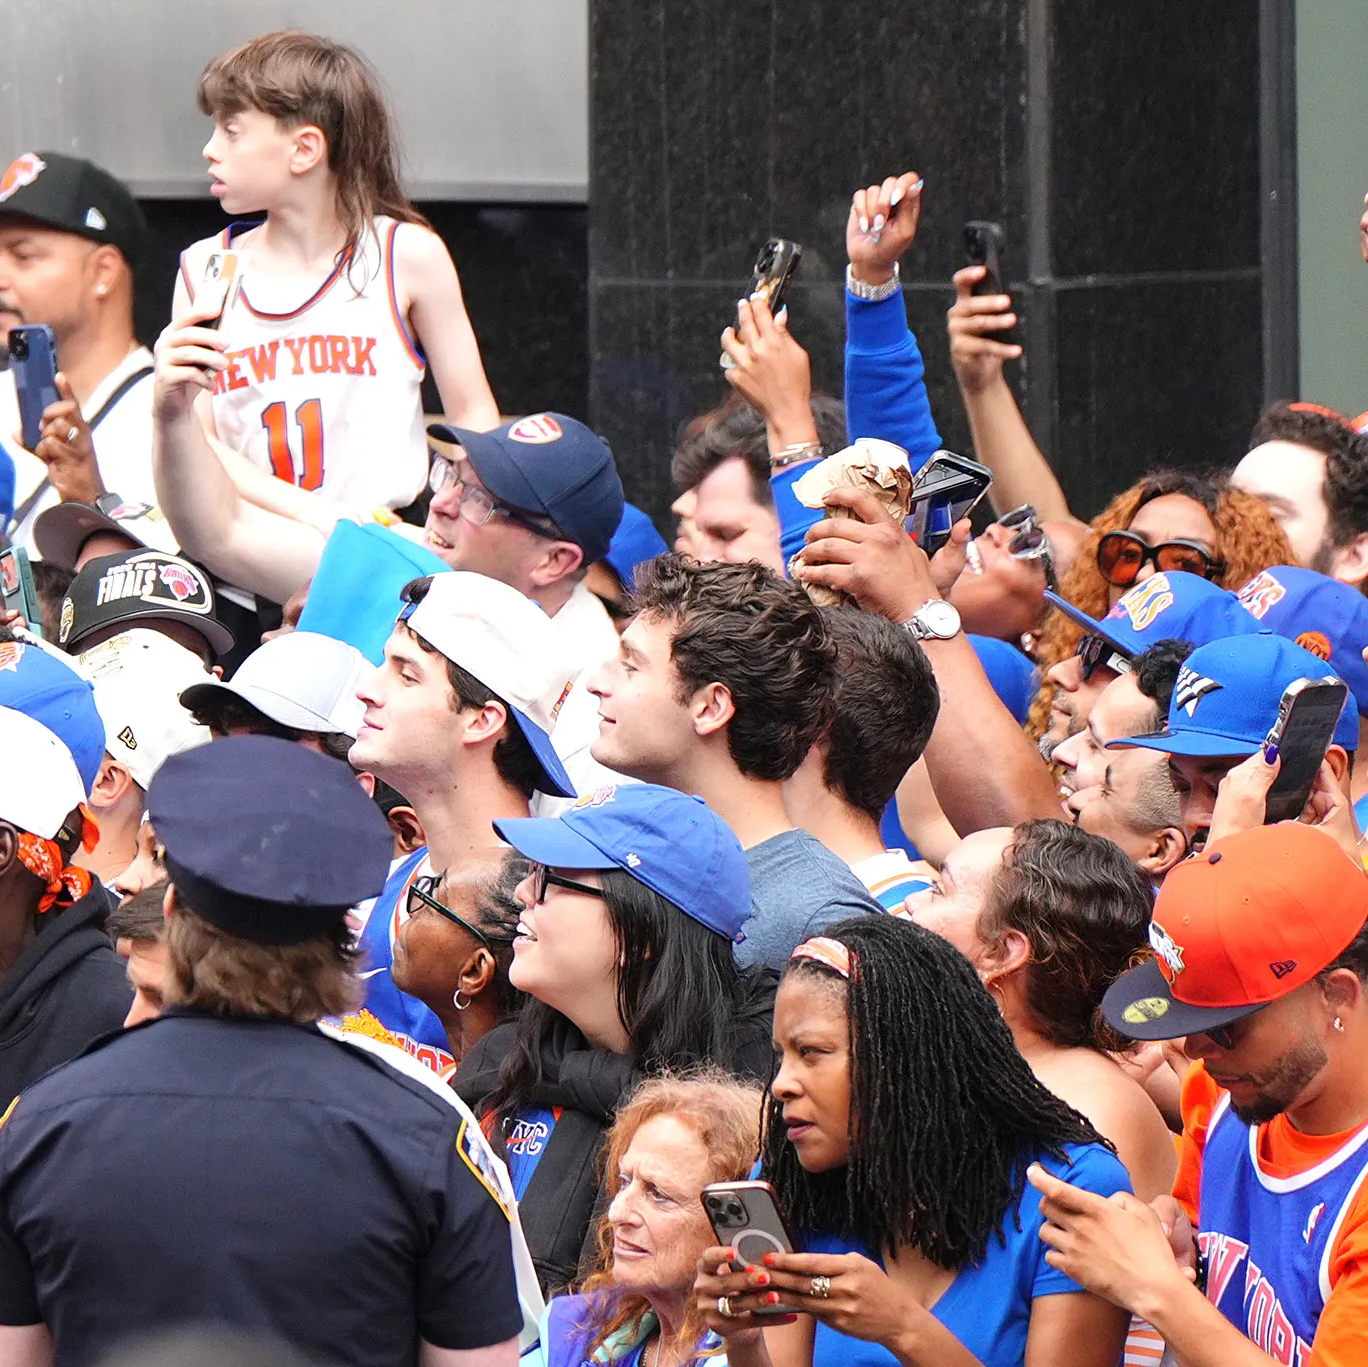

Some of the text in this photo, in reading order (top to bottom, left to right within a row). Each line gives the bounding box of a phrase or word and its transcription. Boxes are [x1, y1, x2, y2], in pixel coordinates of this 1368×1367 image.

[283, 334, 377, 377] YORK
[260, 398, 325, 492] 11
[97, 569, 157, 606] FINALS
